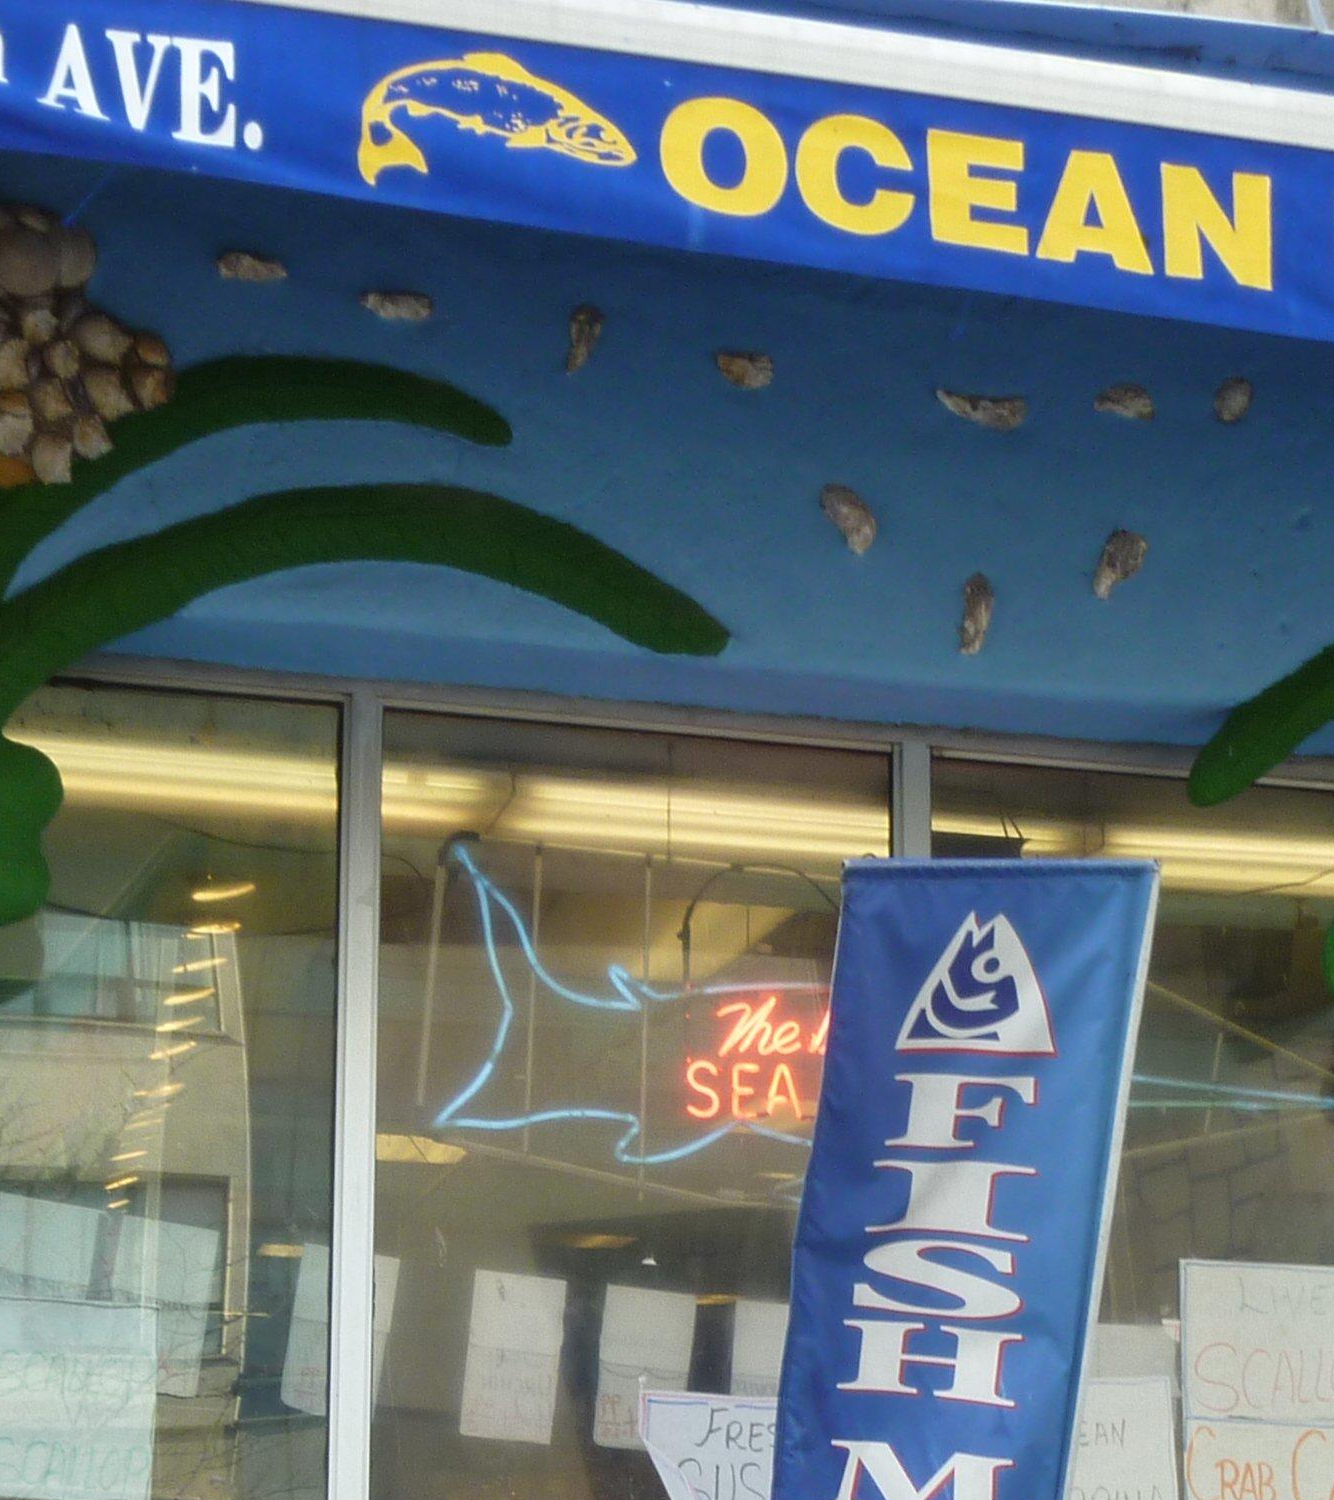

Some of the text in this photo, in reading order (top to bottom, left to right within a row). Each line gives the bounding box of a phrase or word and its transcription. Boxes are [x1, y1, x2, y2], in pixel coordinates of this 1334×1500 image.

[37, 24, 264, 150] AVE.
[659, 96, 1272, 291] OCEAN
[716, 995, 801, 1057] The
[685, 1062, 804, 1121] SEA
[836, 1073, 1039, 1409] FISH
